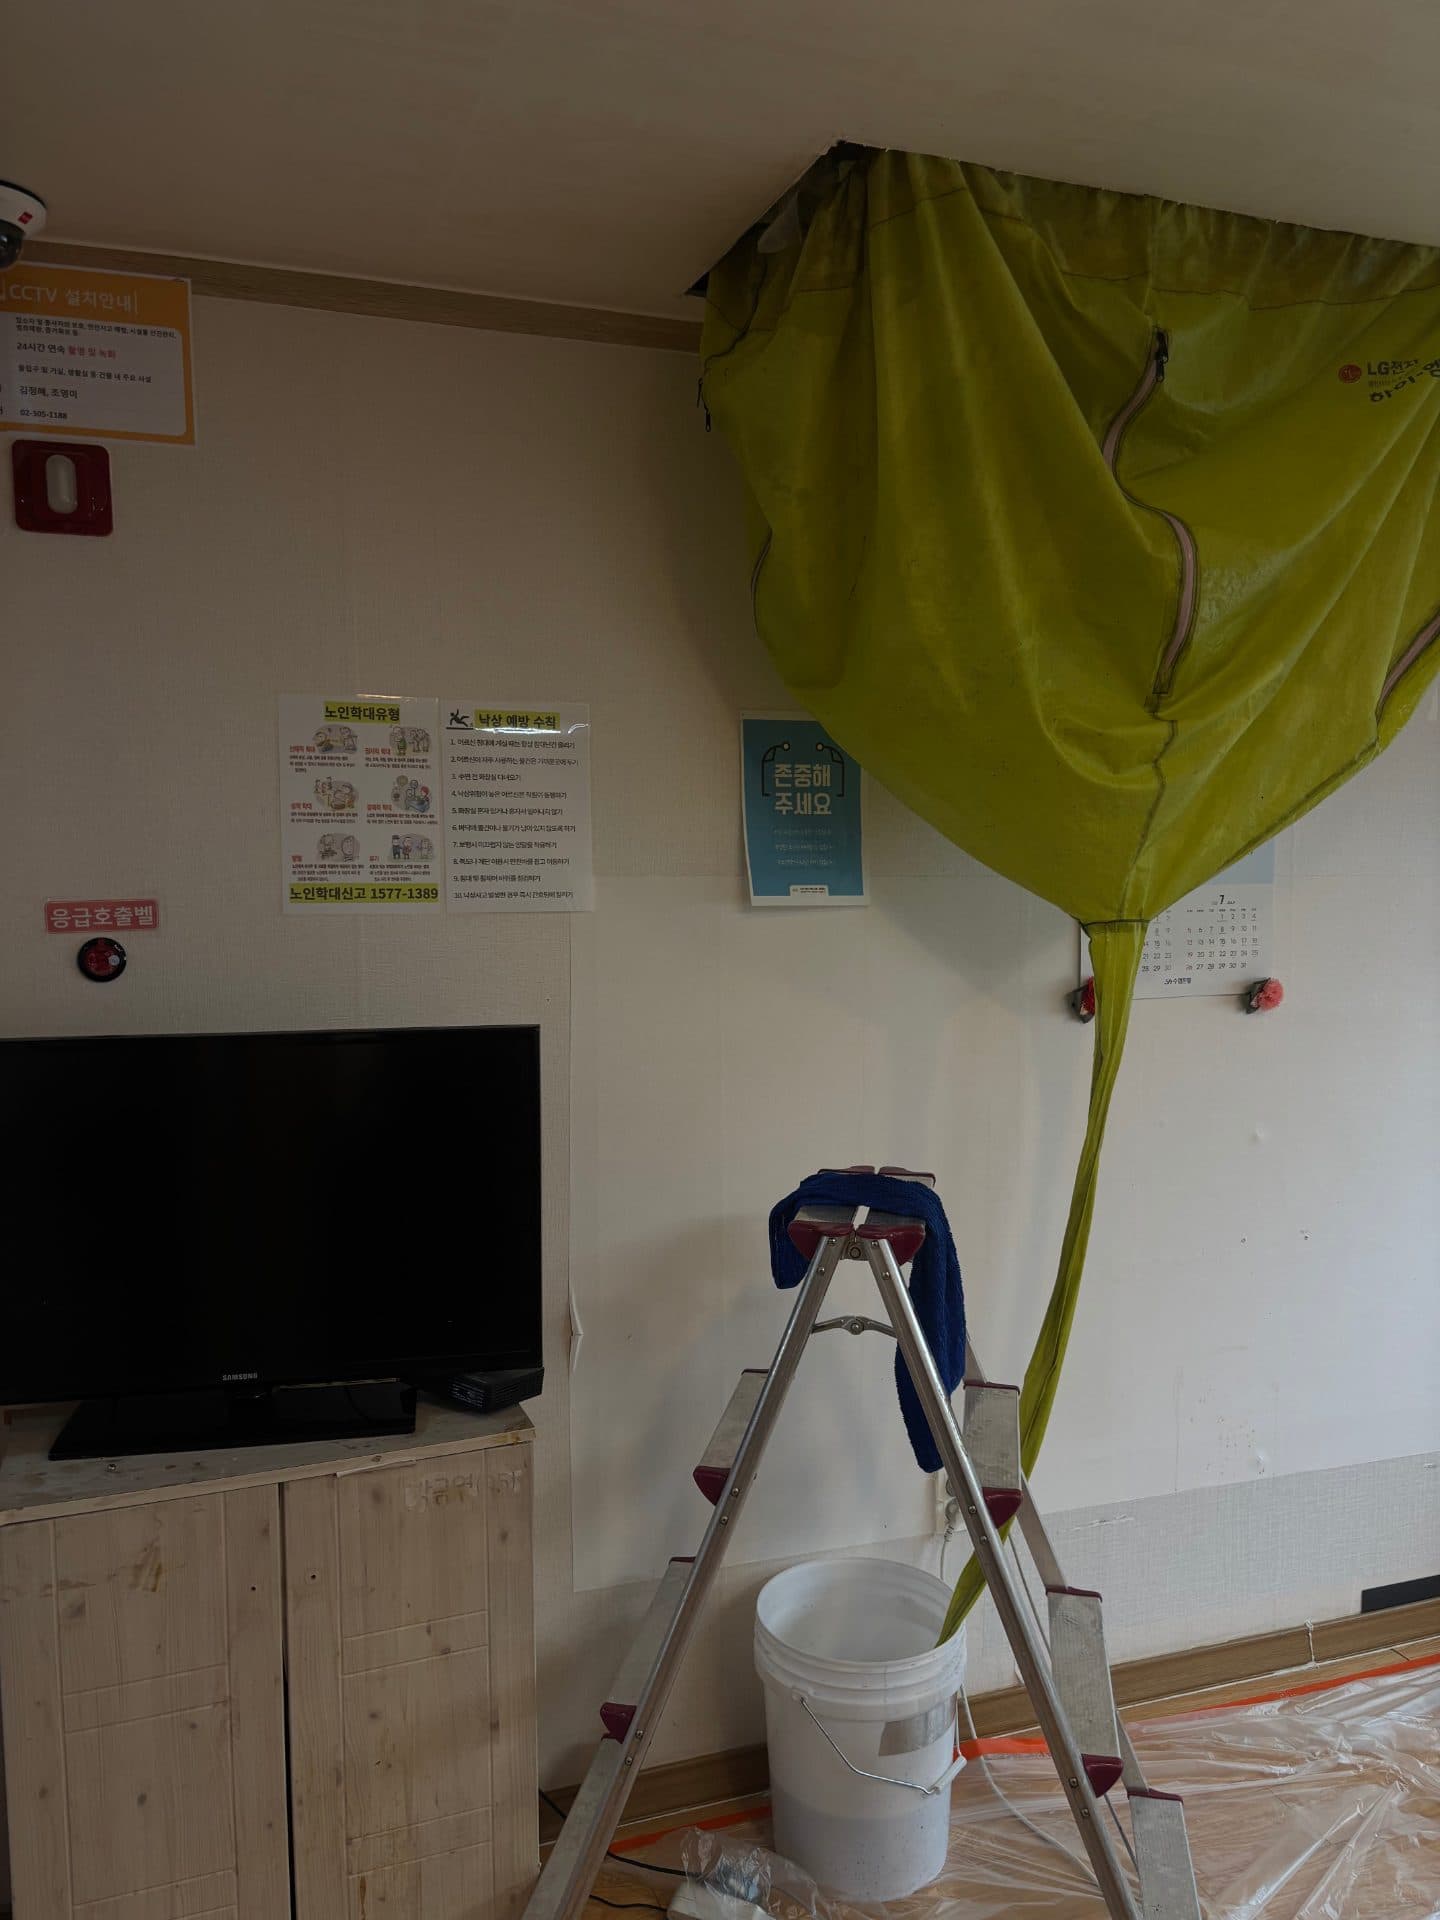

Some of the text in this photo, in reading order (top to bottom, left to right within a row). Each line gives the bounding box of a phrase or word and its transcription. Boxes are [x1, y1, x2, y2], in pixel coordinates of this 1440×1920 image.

[10, 285, 131, 312] CCTV 설치안내
[17, 342, 45, 353] 24시간
[48, 344, 65, 354] 연속
[325, 706, 400, 721] 노인학대유형
[479, 713, 556, 729] 낙상 예방 수칙
[775, 763, 832, 788] 존중해
[774, 792, 832, 815] 주세요
[290, 887, 438, 901] 노인학대신고 1577-1389
[1219, 894, 1225, 905] 7
[50, 905, 153, 928] 응급호출벨
